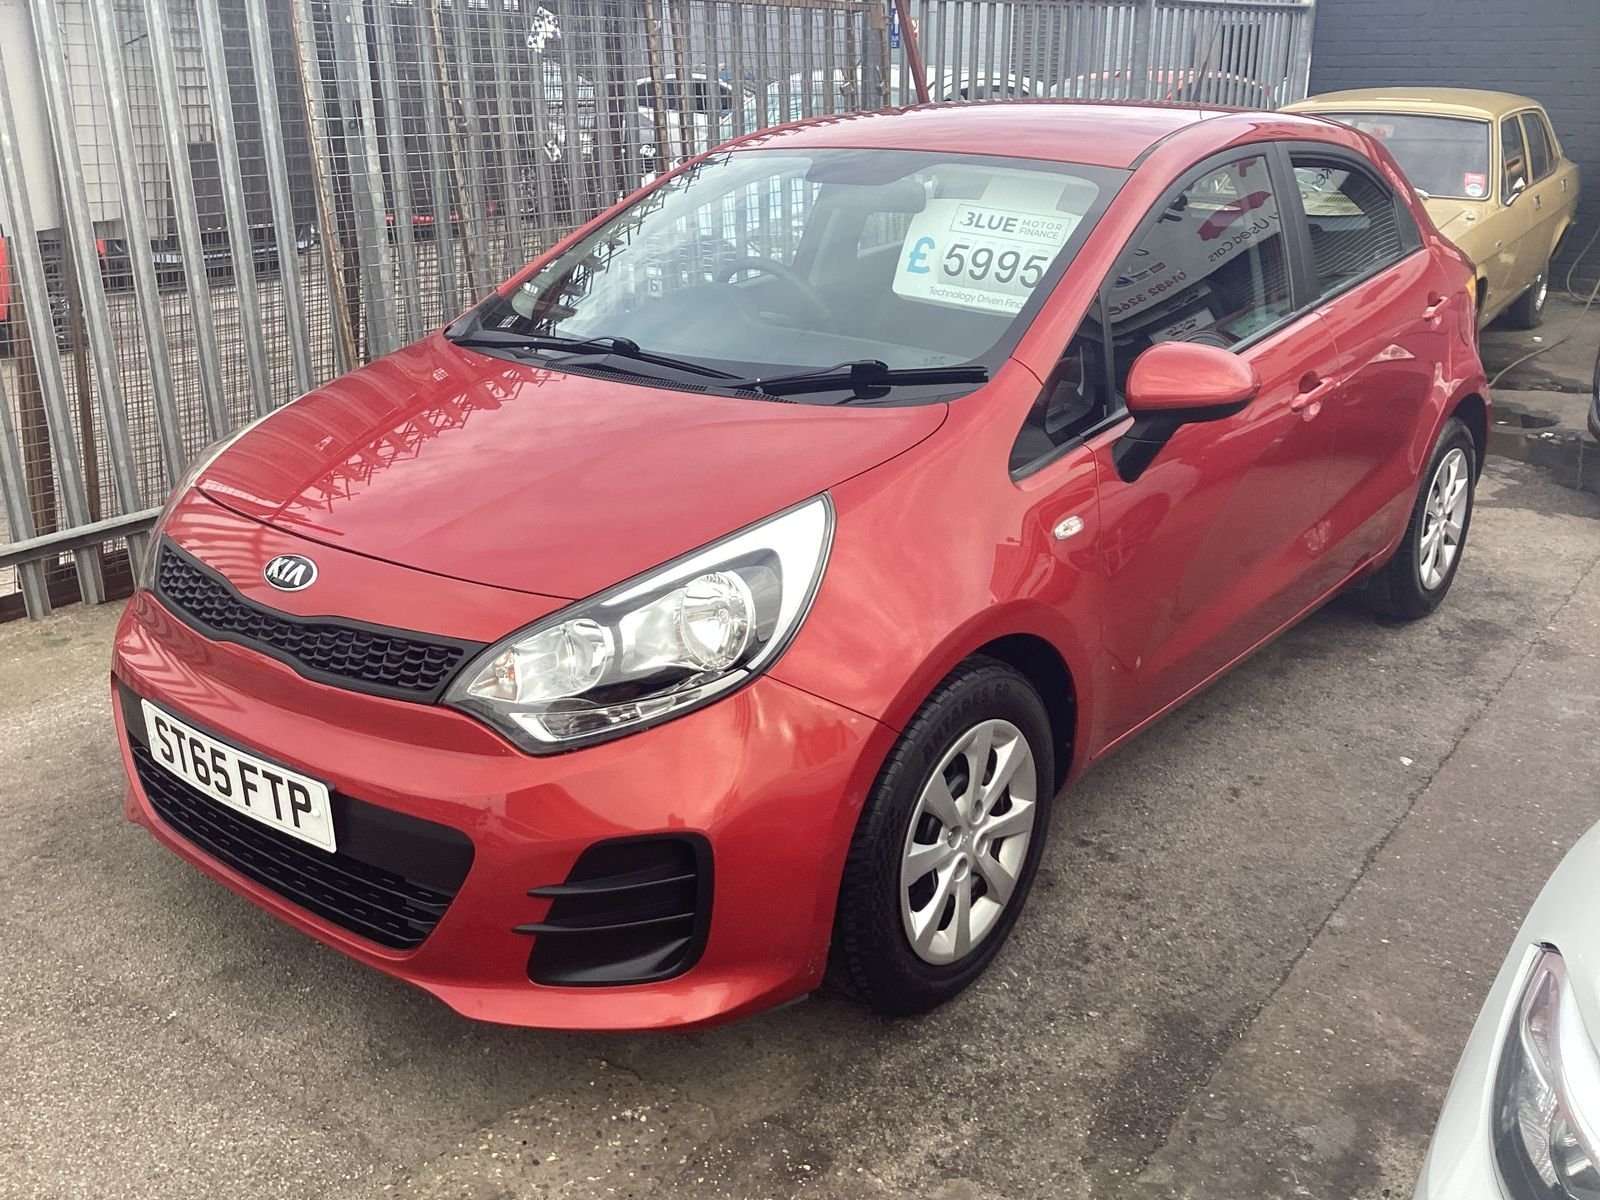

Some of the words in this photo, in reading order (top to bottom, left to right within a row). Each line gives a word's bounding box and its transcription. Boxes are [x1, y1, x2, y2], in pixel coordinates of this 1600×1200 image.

[1019, 226, 1059, 240] FINANCE
[1022, 219, 1062, 231] MOTOR
[929, 286, 977, 304] Technology
[977, 294, 1005, 306] Driven
[266, 557, 307, 586] KIA
[155, 715, 232, 798] ST65
[237, 759, 312, 829] FTP
